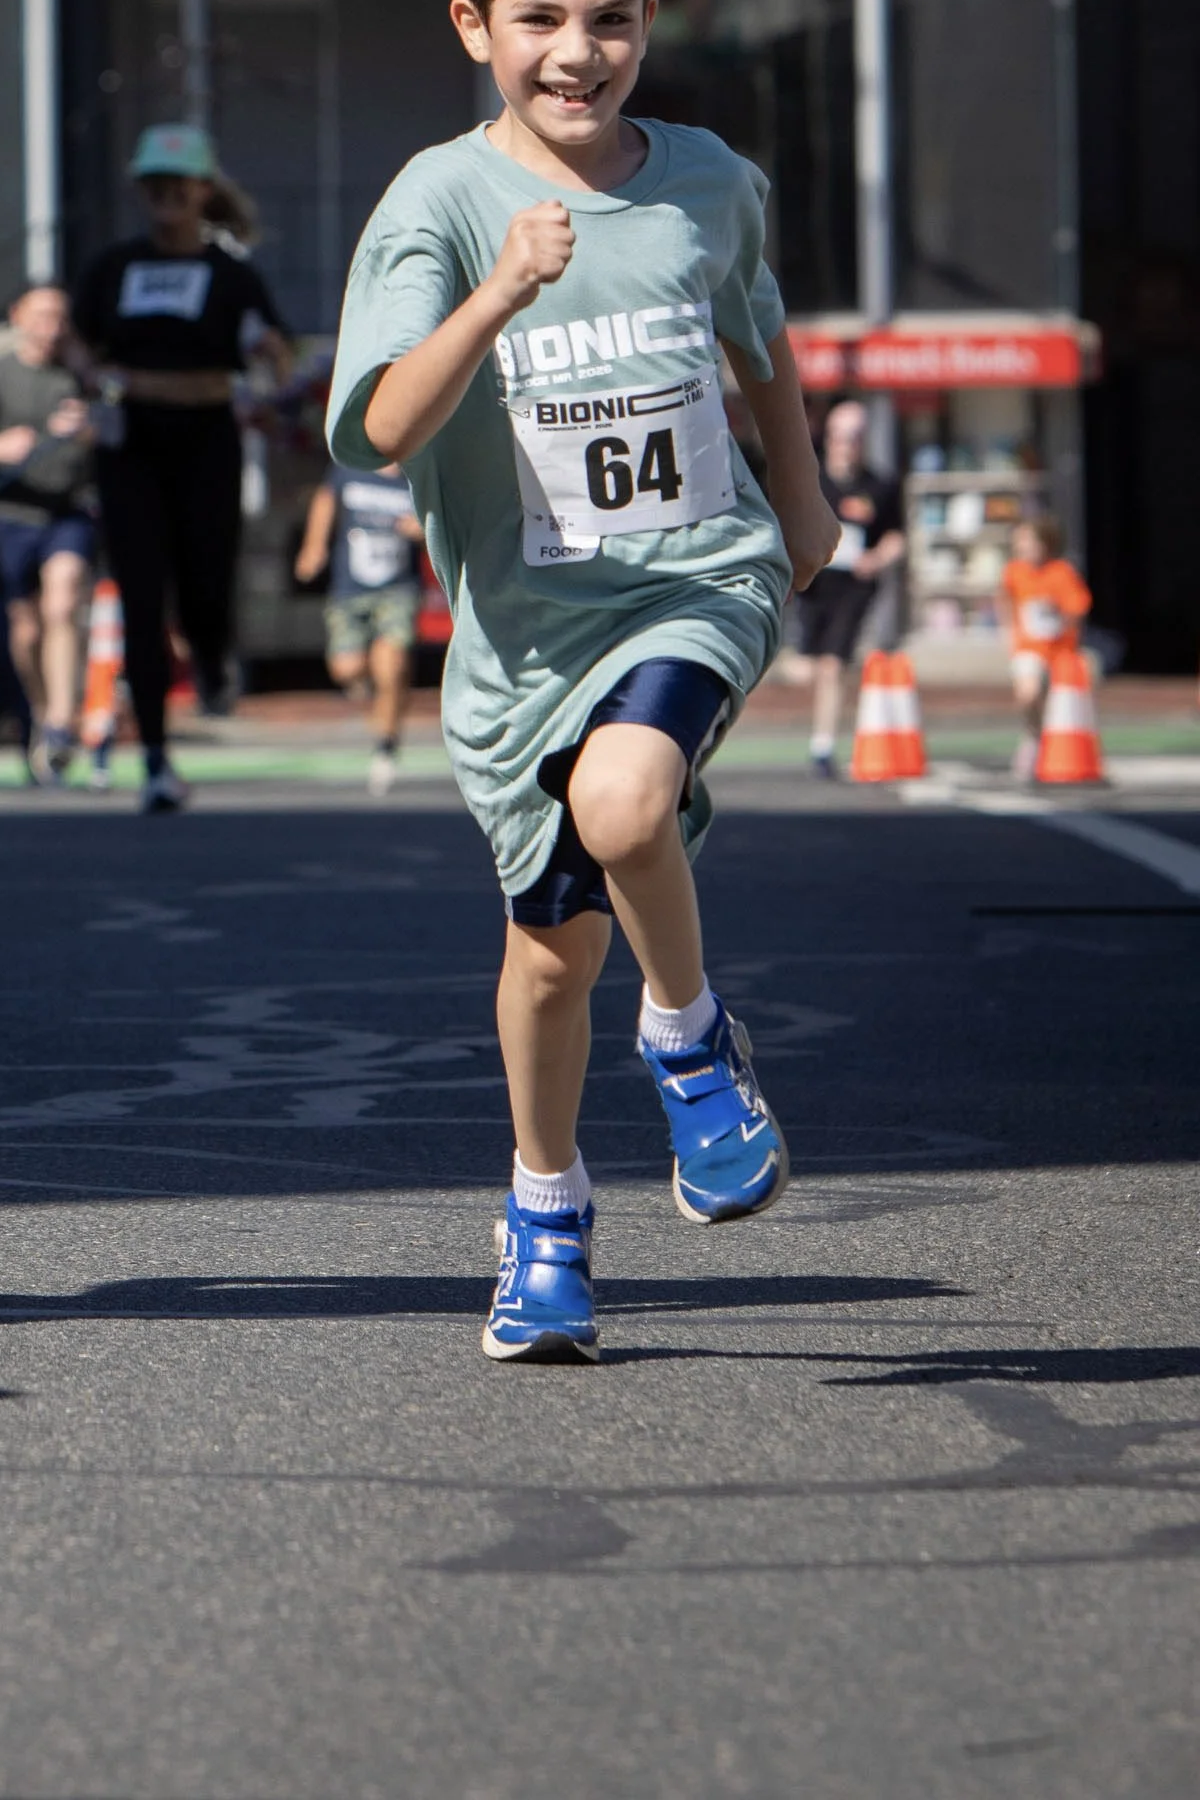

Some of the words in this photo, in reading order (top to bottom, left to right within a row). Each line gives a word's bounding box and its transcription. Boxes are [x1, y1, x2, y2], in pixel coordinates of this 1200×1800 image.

[536, 384, 685, 425] BIONIC
[585, 428, 683, 511] 64
[540, 545, 583, 559] FOOD
